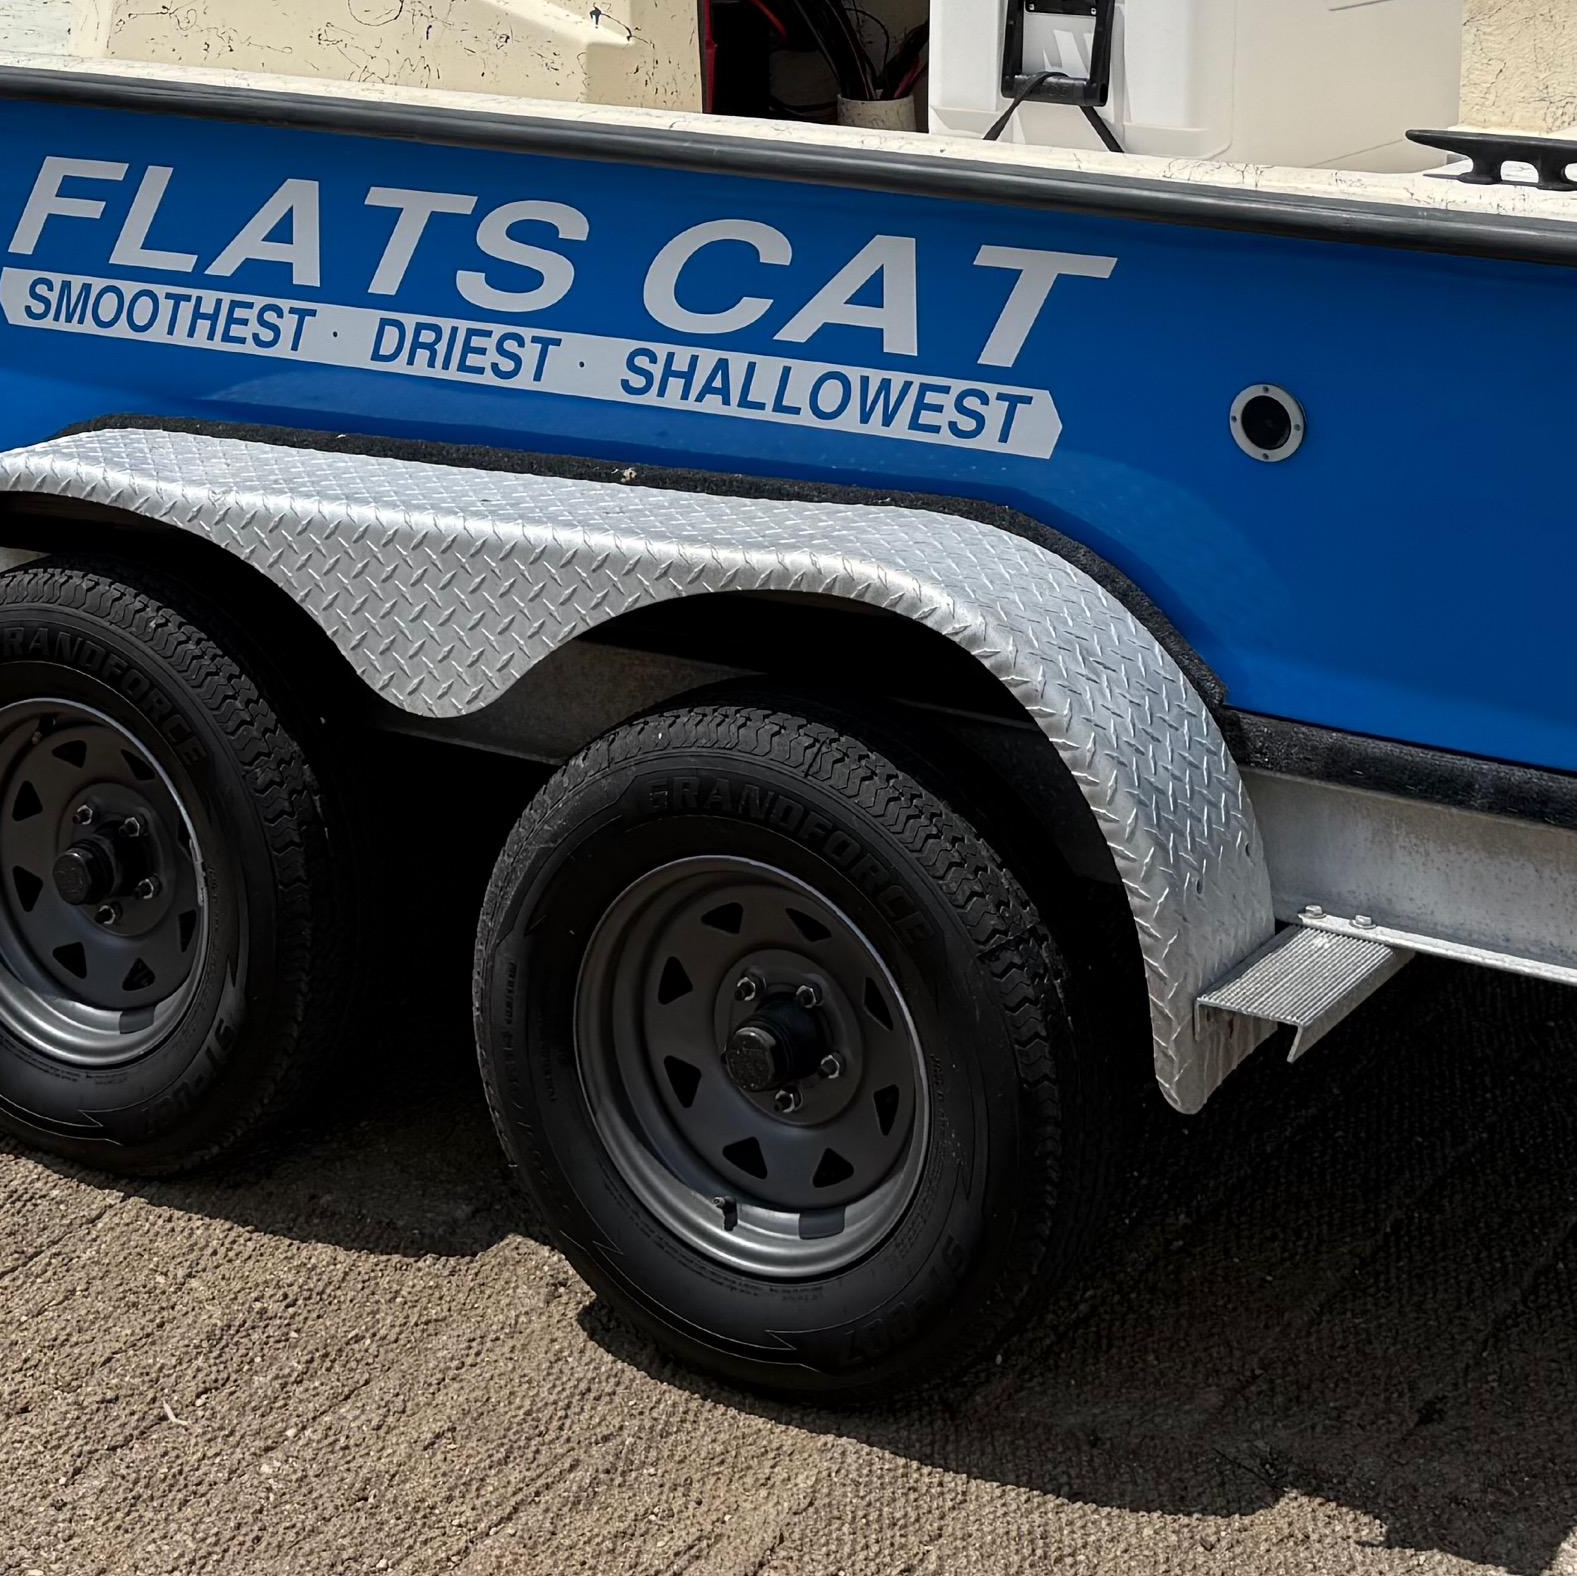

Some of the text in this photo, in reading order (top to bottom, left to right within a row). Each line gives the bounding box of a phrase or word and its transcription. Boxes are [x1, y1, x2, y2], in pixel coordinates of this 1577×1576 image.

[7, 155, 1118, 368] FLATS CAT
[24, 276, 1033, 444] SMOOTHEST DRIEST SHALLOWEST
